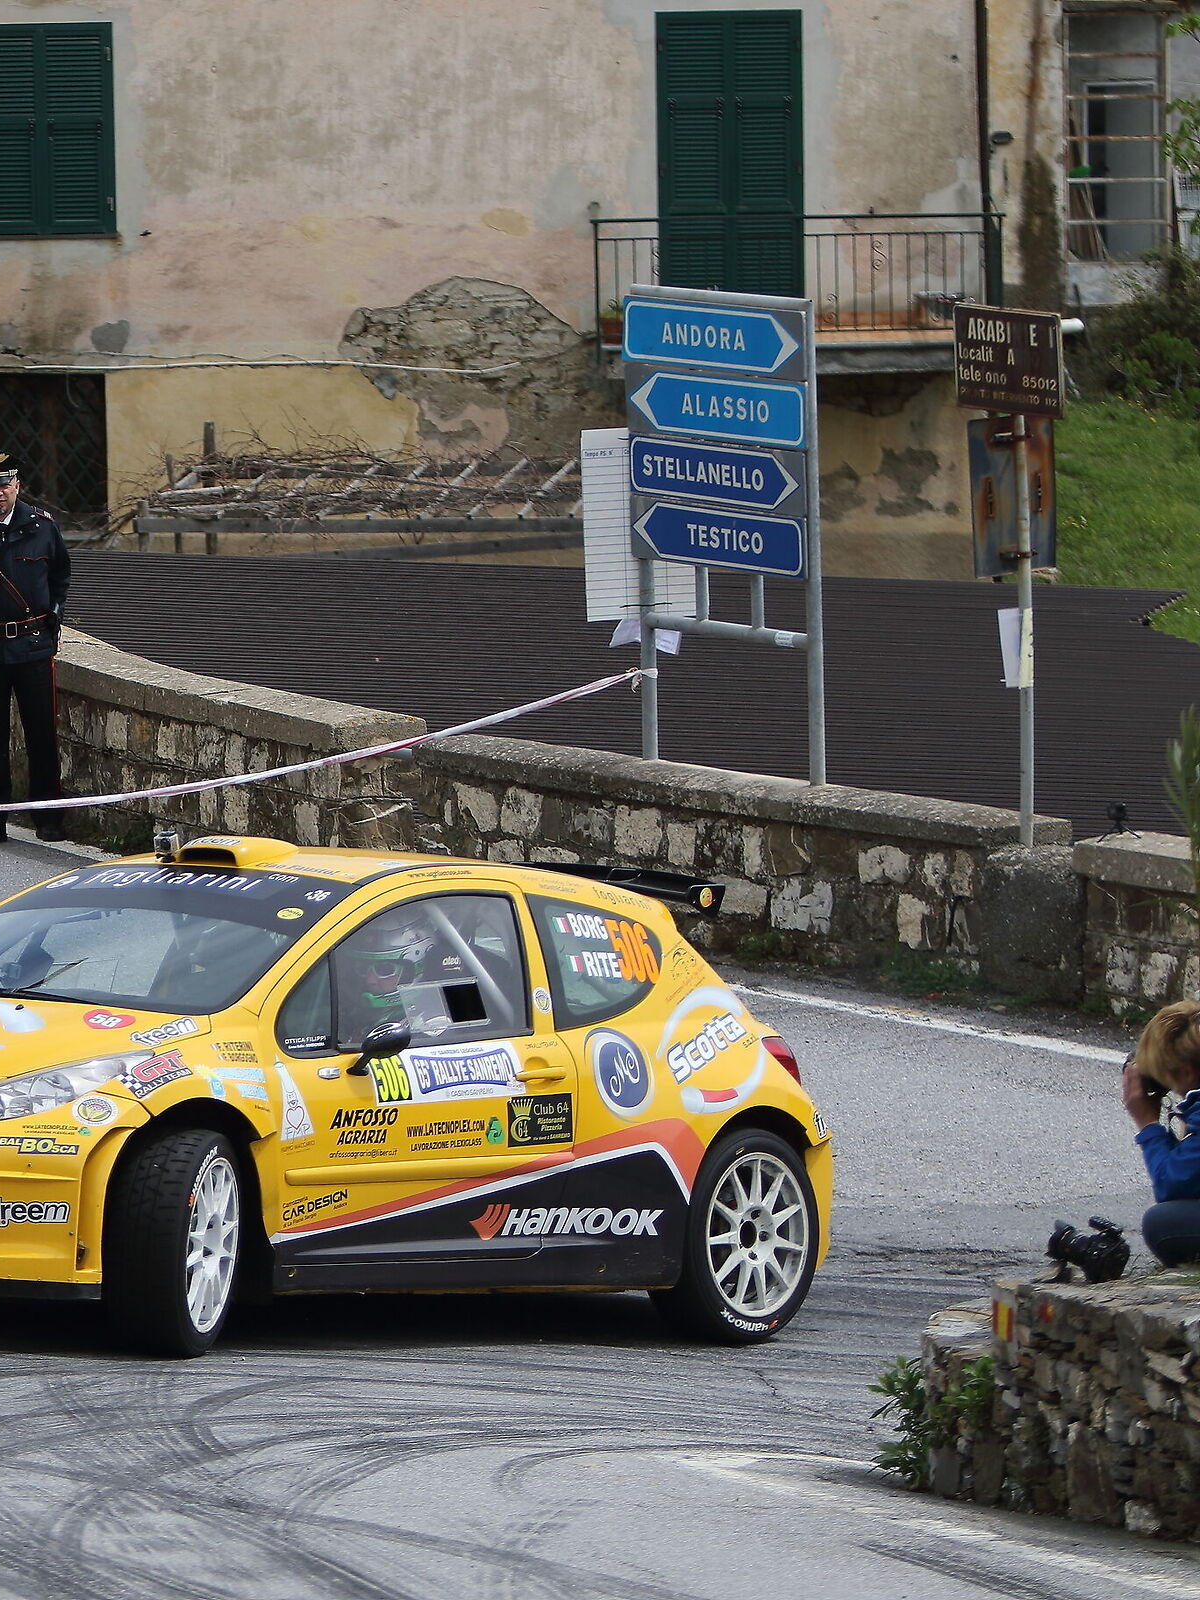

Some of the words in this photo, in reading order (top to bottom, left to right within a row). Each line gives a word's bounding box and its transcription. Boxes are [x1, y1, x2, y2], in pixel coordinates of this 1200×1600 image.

[661, 322, 746, 351] ANDORA
[1022, 375, 1057, 391] 85012
[681, 391, 770, 423] ALASSIO
[642, 454, 764, 492] STELLANELLO
[687, 523, 764, 555] TESTICO
[84, 867, 262, 892] fogliarini
[603, 918, 660, 986] 506
[88, 1013, 123, 1028] 58
[131, 1016, 198, 1046] freem
[667, 1011, 747, 1085] Scotta
[131, 1050, 186, 1082] GRT
[371, 1055, 411, 1102] 506
[430, 1059, 470, 1086] RALLYE
[467, 1052, 513, 1082] SANREMO
[135, 1078, 164, 1098] RALLY
[166, 1068, 192, 1080] TEAM
[330, 1107, 399, 1130] ANFOSSO
[533, 1102, 555, 1116] Club
[557, 1101, 569, 1114] 64
[337, 1129, 387, 1145] AGRARIA
[406, 1119, 485, 1138] WWW.LATECNOPLEX.COM
[411, 1140, 449, 1151] LAVORAZIONE
[450, 1138, 482, 1148] PLEXIGLASS
[283, 1205, 305, 1221] CAR
[307, 1189, 348, 1212] DESIGN
